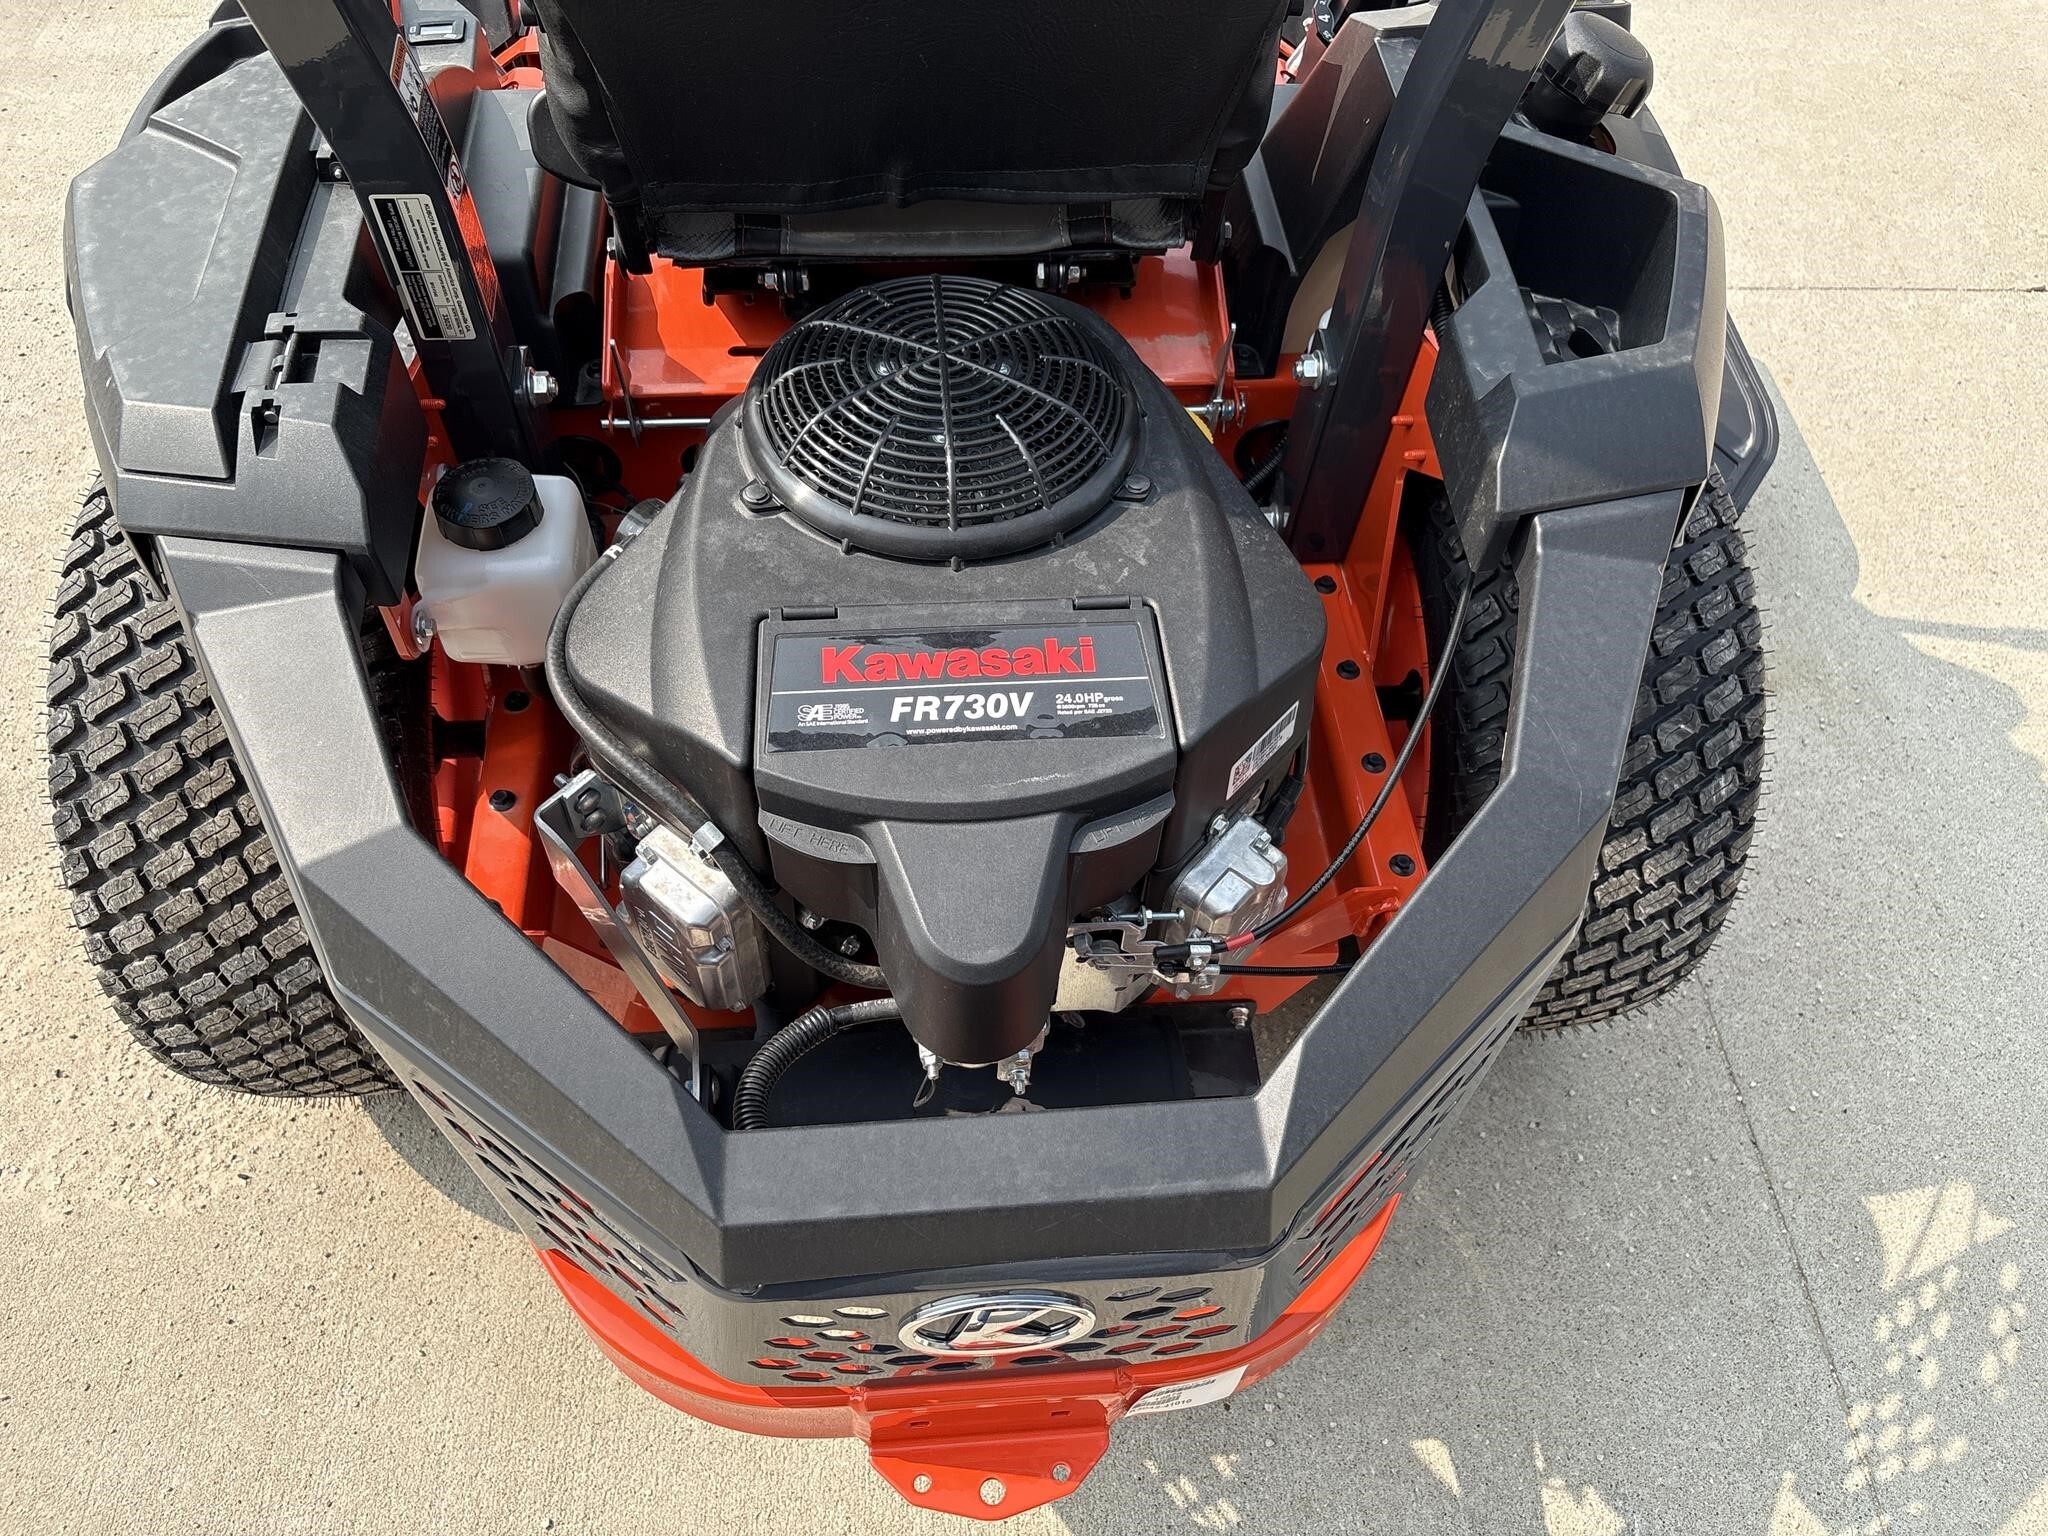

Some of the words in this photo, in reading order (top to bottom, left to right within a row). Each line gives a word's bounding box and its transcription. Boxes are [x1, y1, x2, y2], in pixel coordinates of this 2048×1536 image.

[423, 203, 435, 225] KUBOTA
[478, 496, 506, 513] SEE
[820, 636, 1096, 685] Kawasaki
[797, 704, 834, 722] SAE
[889, 691, 1034, 724] FR730V
[906, 723, 1018, 736] www.poweredbykawasaki.com
[769, 818, 803, 838] LIFT
[809, 832, 852, 856] HERE
[1092, 824, 1122, 843] LIFT
